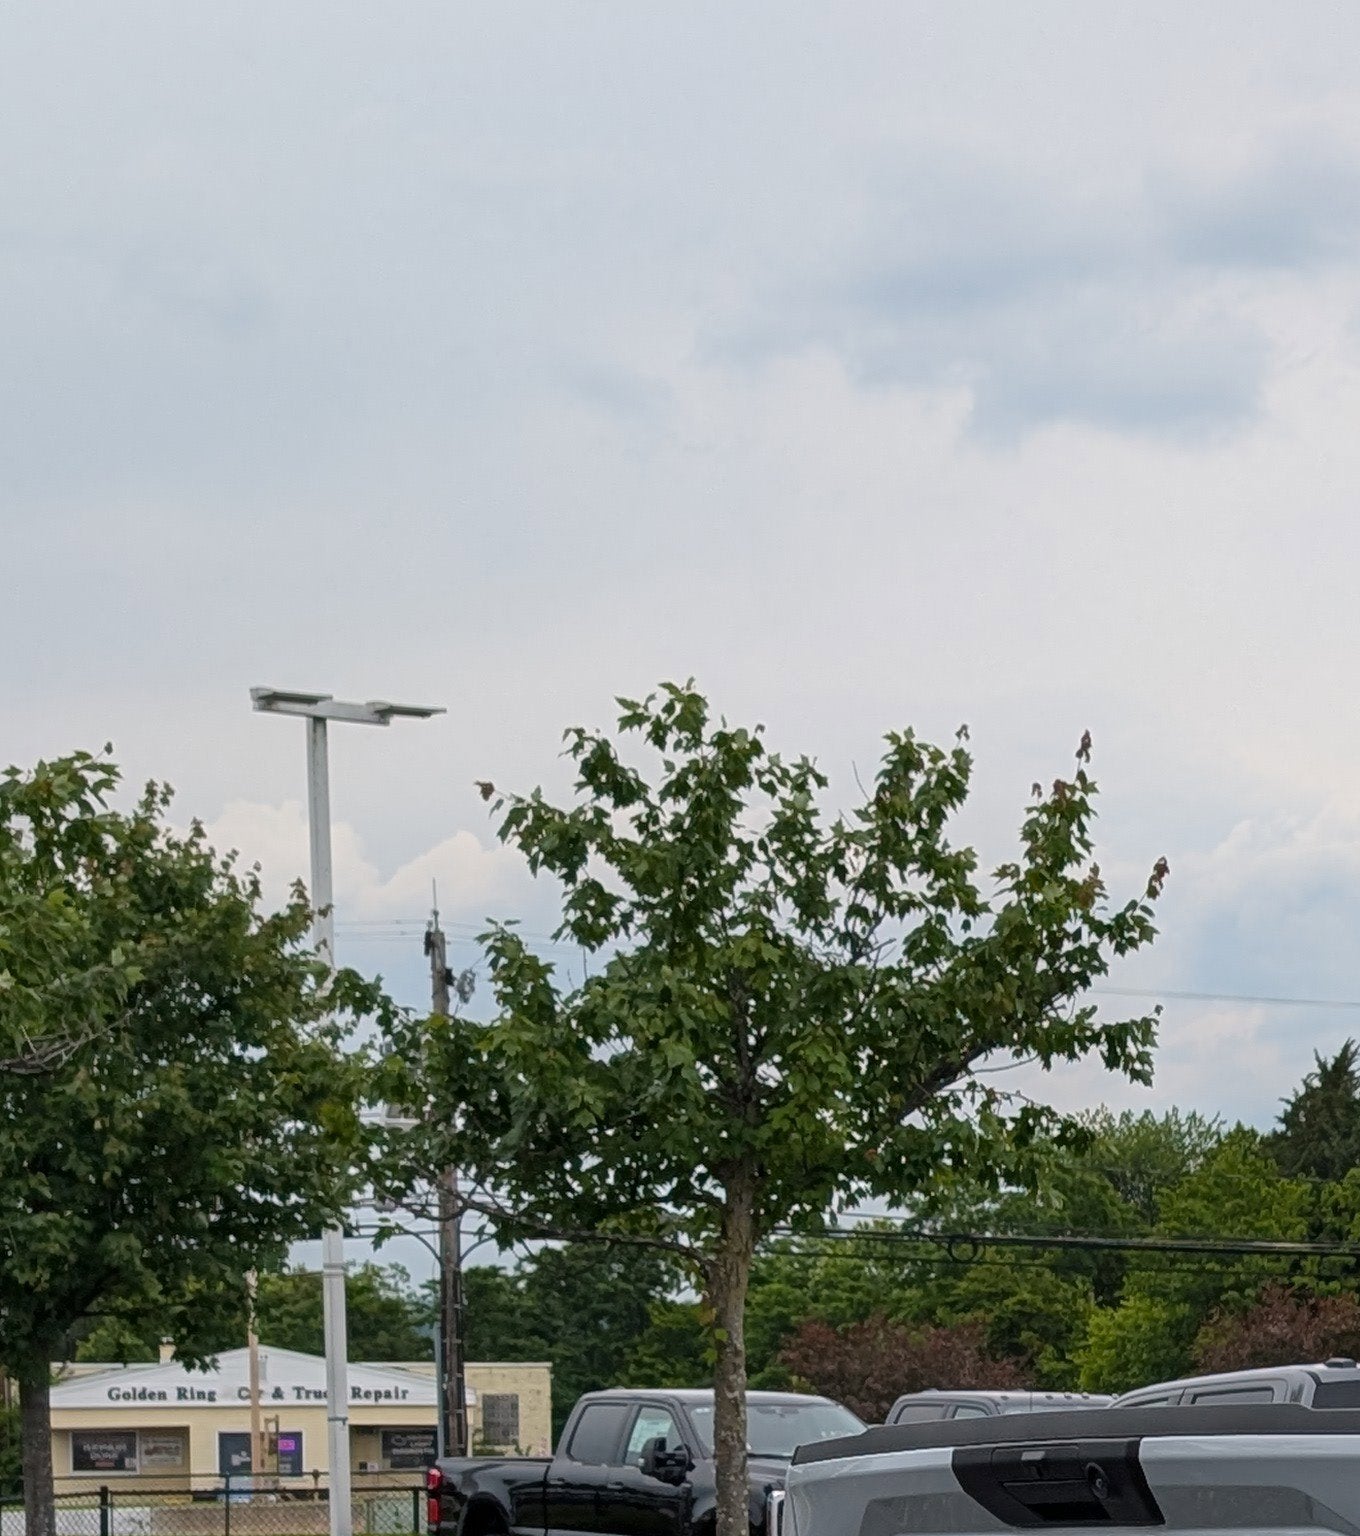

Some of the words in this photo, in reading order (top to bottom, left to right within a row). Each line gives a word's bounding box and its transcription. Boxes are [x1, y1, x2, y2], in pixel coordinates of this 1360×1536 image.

[107, 1386, 168, 1401] Golden
[176, 1386, 217, 1402] Ring
[351, 1386, 409, 1402] Repair
